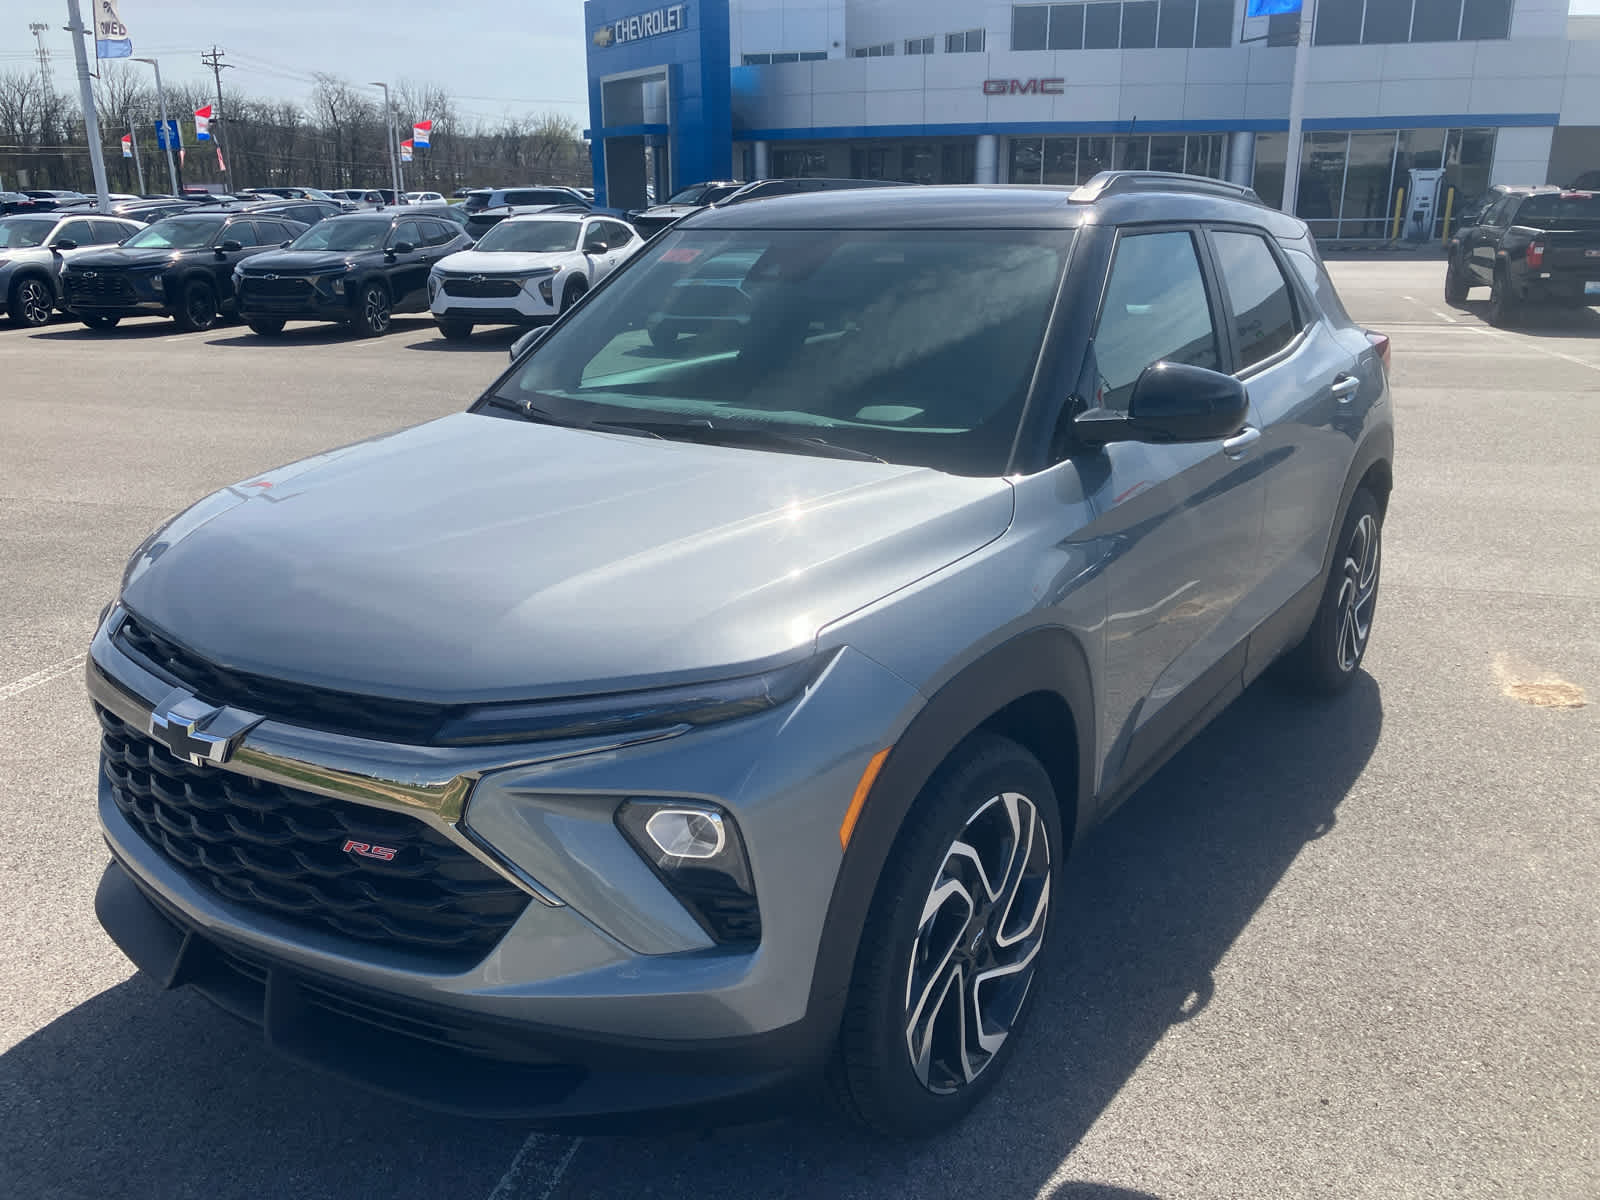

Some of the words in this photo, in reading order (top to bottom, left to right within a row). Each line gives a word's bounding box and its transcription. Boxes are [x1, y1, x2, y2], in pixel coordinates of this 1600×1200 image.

[615, 4, 682, 43] CHEVROLET
[983, 78, 1065, 96] GMC
[342, 840, 398, 861] RS
